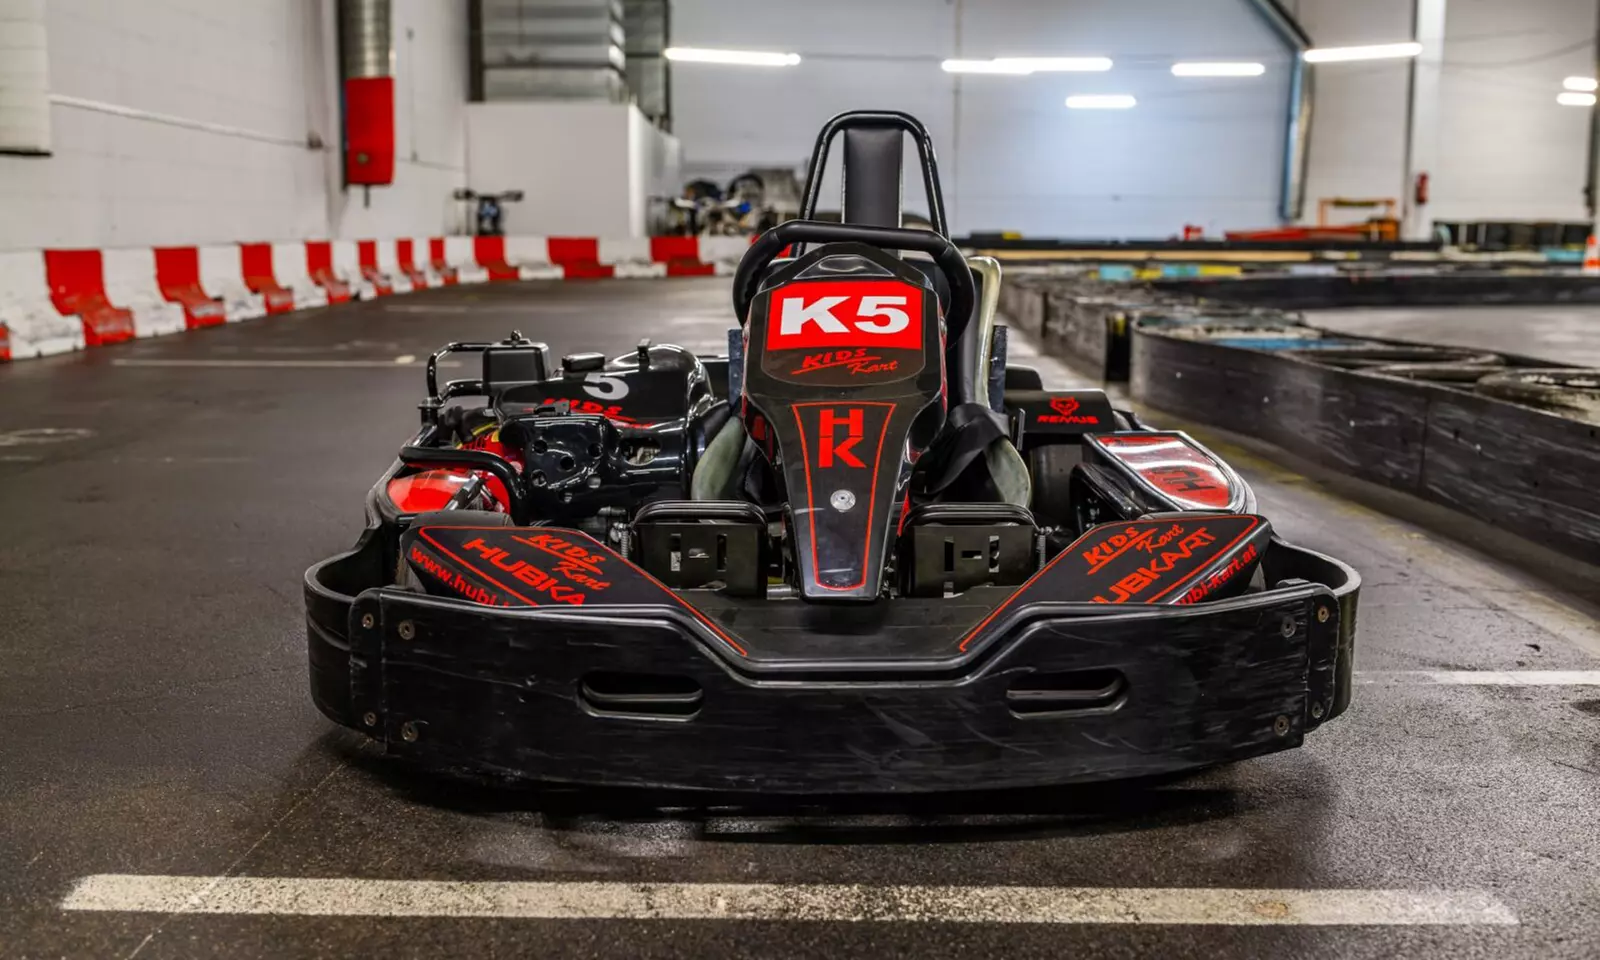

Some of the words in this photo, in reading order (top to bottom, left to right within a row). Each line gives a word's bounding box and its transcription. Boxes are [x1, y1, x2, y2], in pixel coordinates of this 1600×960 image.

[780, 296, 910, 335] K5
[802, 348, 868, 368] KIDS
[847, 360, 898, 375] Kart
[582, 371, 630, 400] 5
[1036, 414, 1100, 424] REMUS
[527, 534, 606, 564] KIDS
[1082, 526, 1140, 566] KIDS
[1136, 524, 1184, 554] Kart
[411, 547, 509, 608] www.hubi
[552, 560, 611, 591] Kart
[1175, 543, 1257, 606] ubi-kart.at
